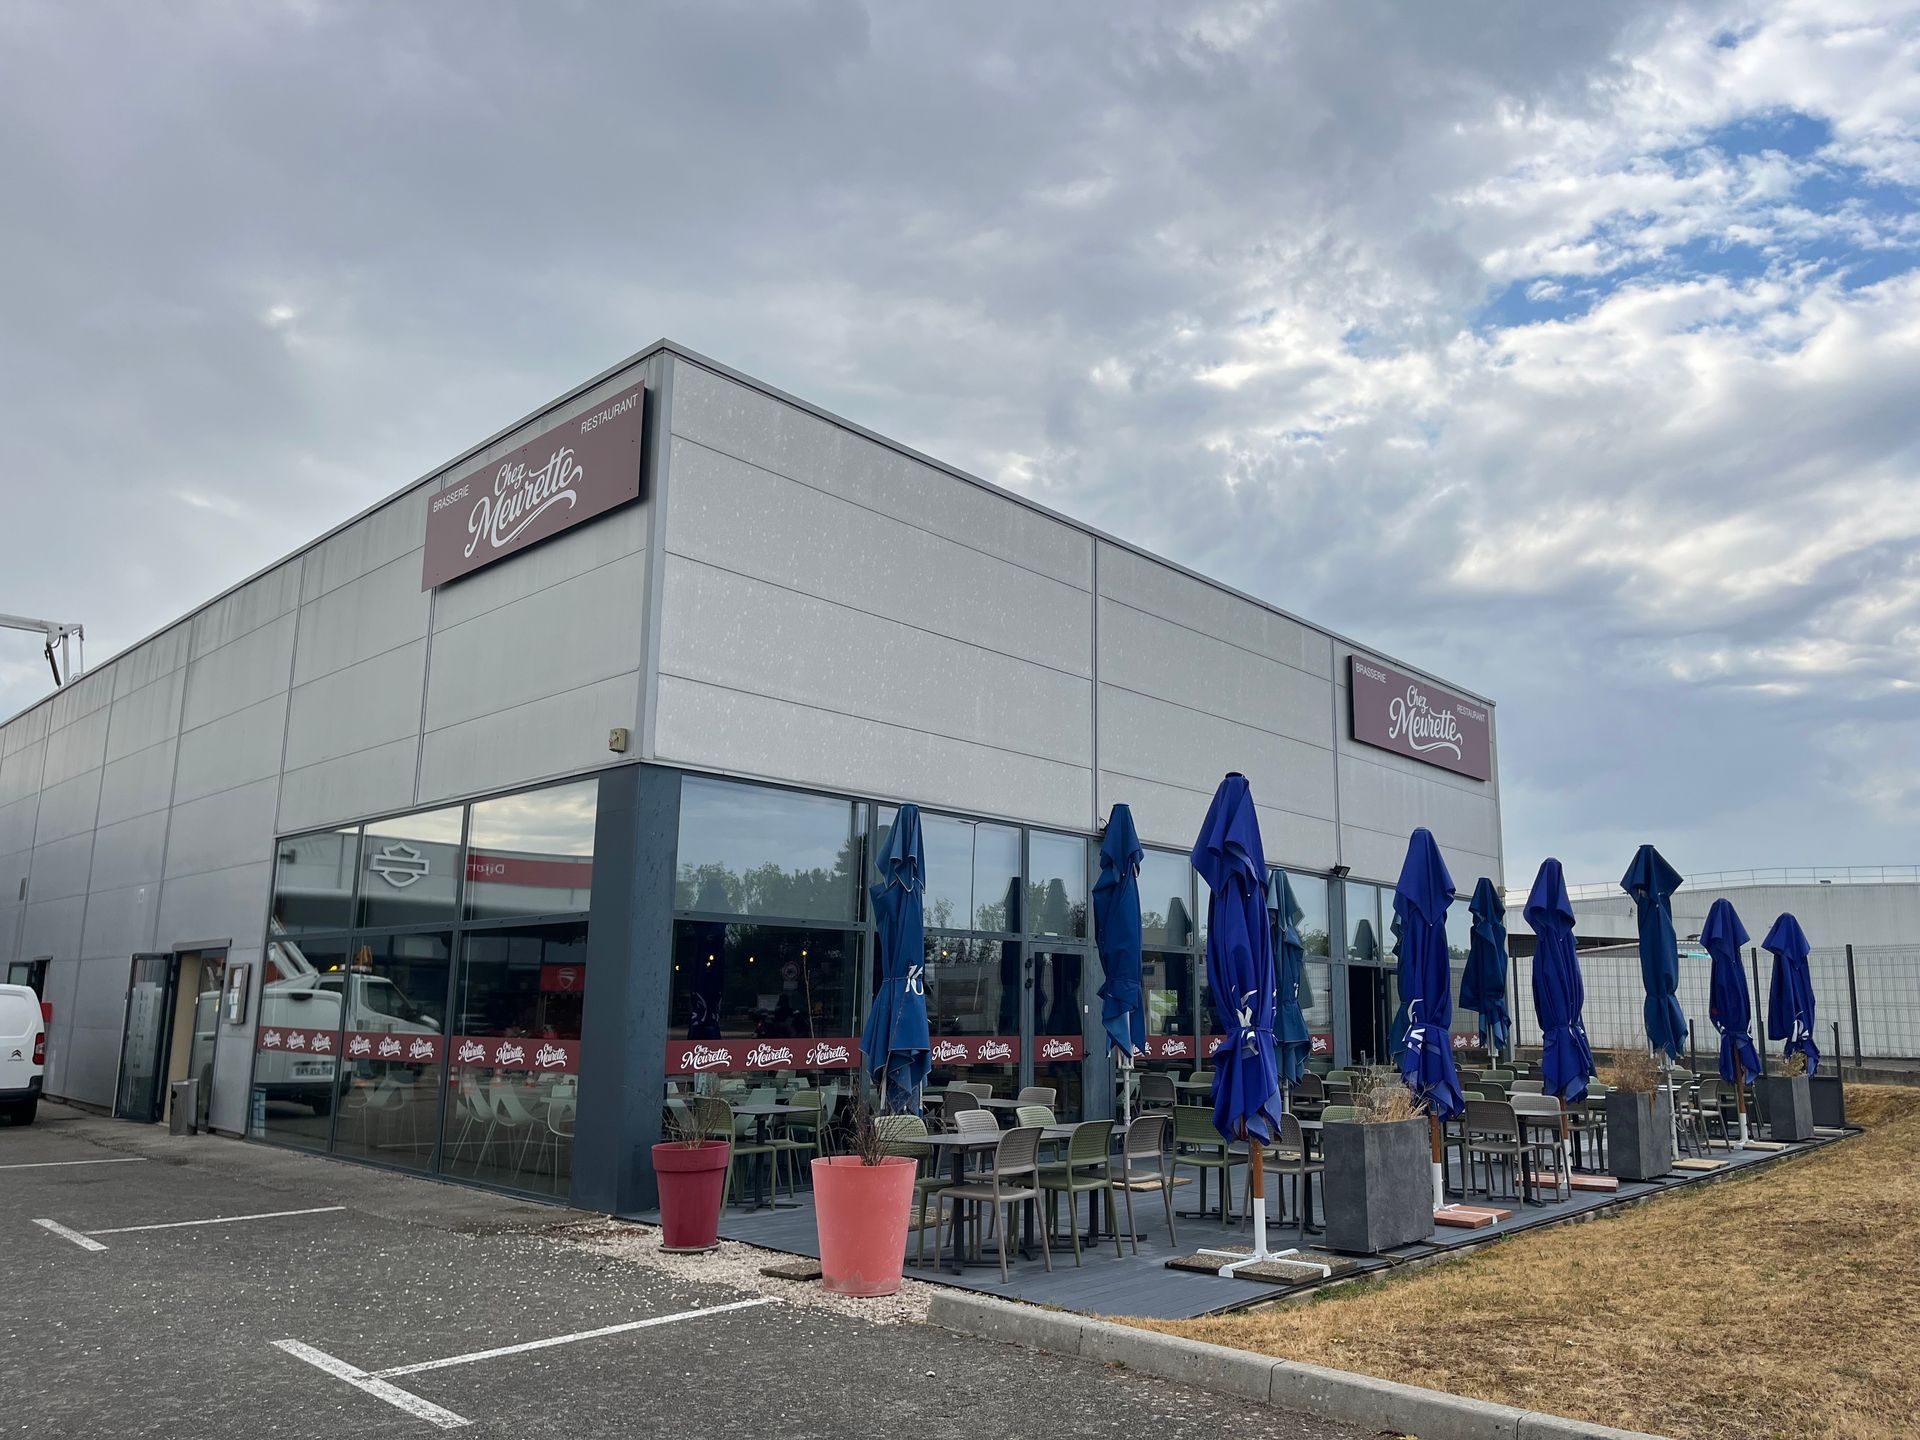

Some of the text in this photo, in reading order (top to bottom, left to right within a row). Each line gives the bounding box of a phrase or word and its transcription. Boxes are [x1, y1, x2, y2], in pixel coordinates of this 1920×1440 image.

[580, 393, 639, 434] RESTAURANT
[494, 462, 527, 496] Chez
[433, 484, 470, 512] BRASSERIE
[464, 446, 583, 558] Meurette
[1355, 662, 1387, 683] BRASSERIE
[1406, 685, 1429, 714] Chez
[1456, 704, 1486, 722] RESTAURANT
[1388, 697, 1463, 760] Meurette
[680, 1047, 732, 1070] Meurette
[745, 1046, 793, 1068] Meurette
[805, 1045, 850, 1066] Meurette
